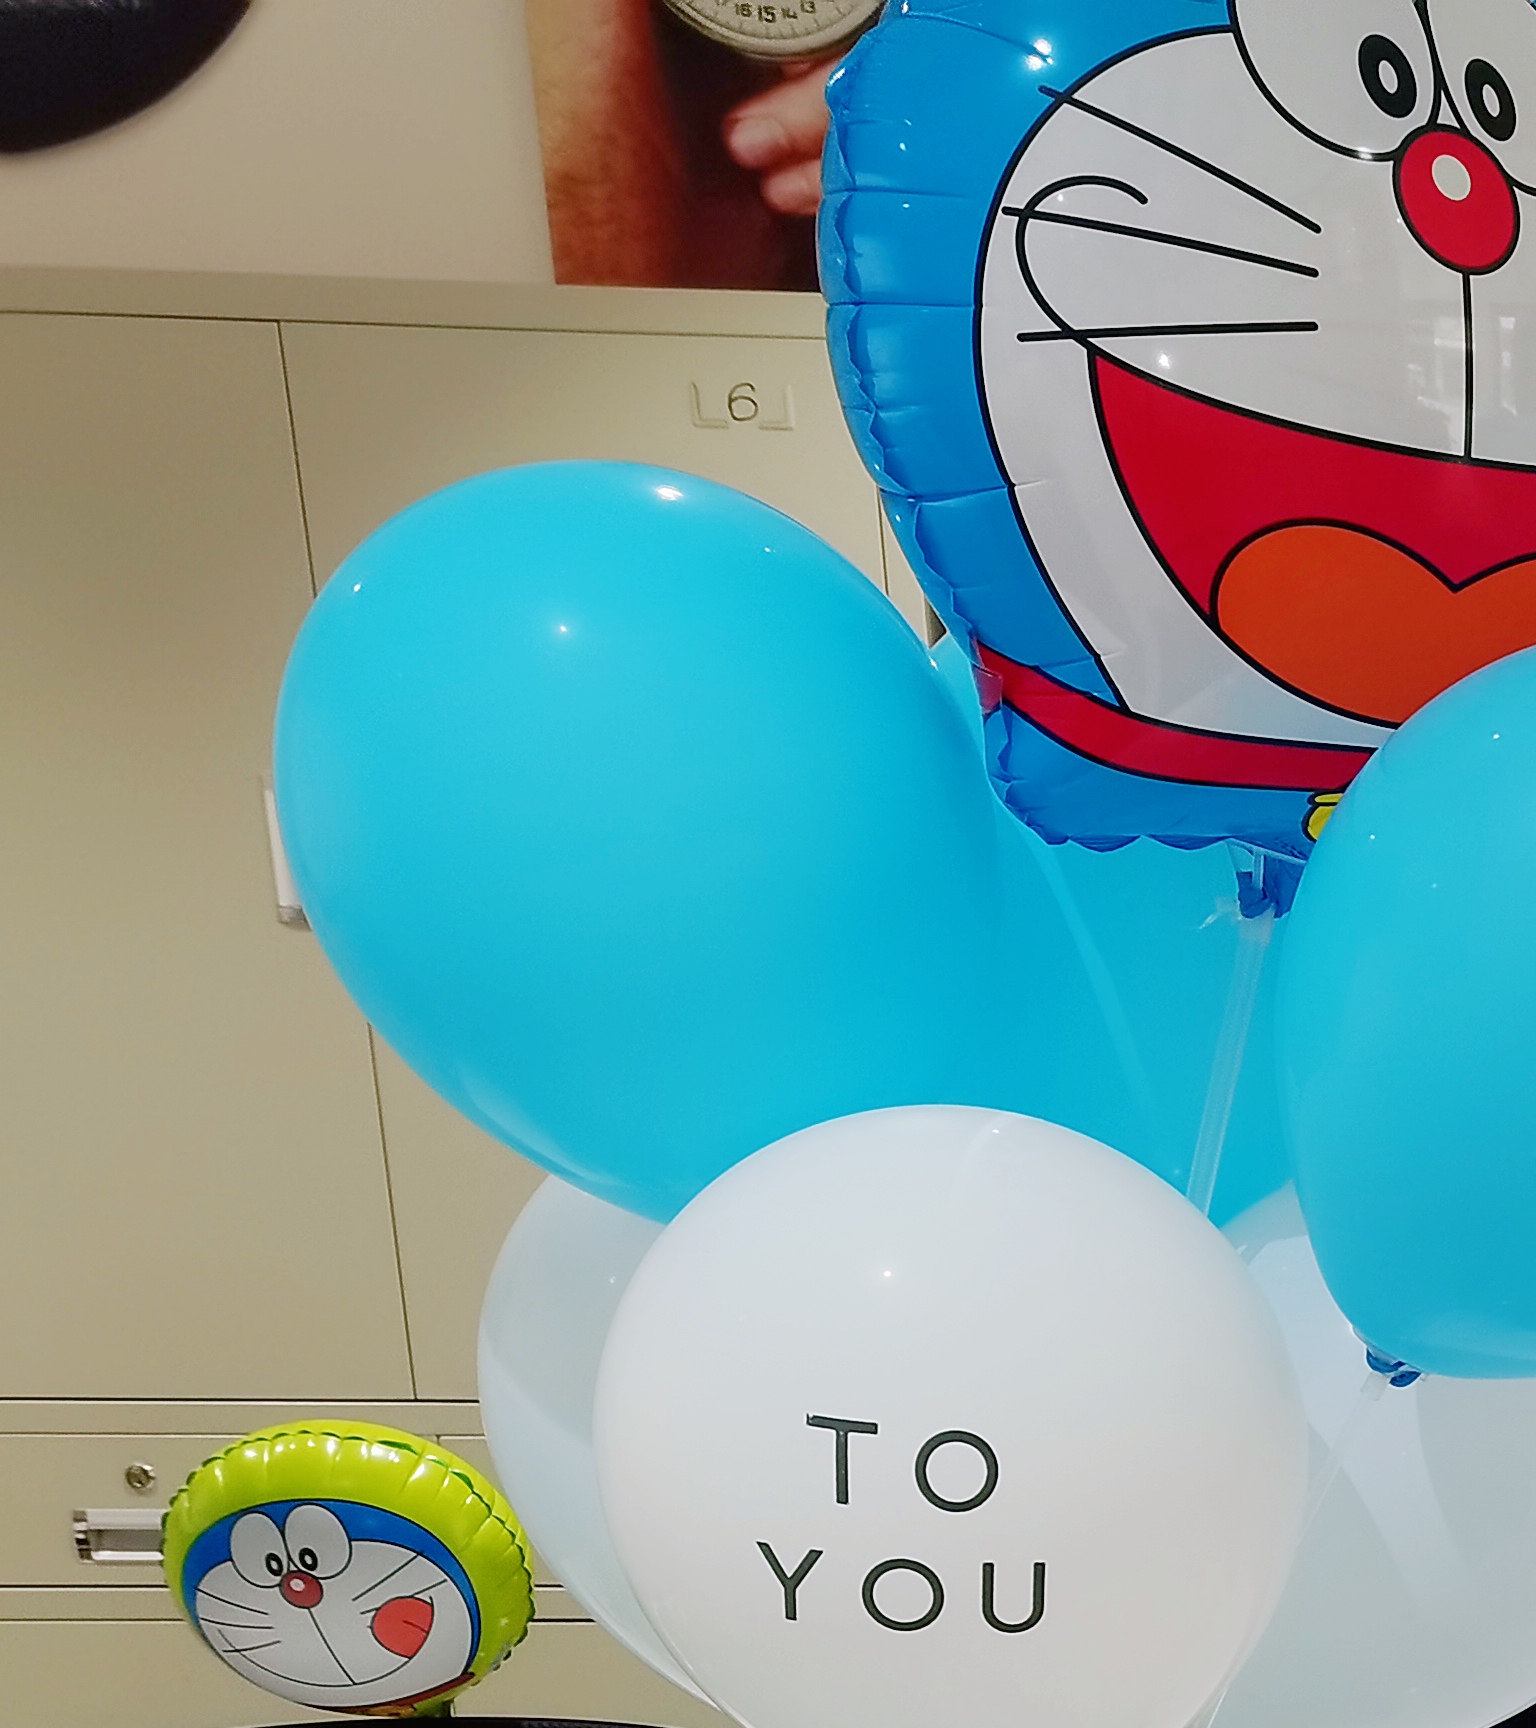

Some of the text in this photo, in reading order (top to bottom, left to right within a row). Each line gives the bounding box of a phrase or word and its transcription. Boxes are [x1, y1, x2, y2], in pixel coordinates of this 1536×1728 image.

[726, 379, 760, 423] 6
[805, 1412, 999, 1513] TO
[755, 1540, 1046, 1633] YOU
